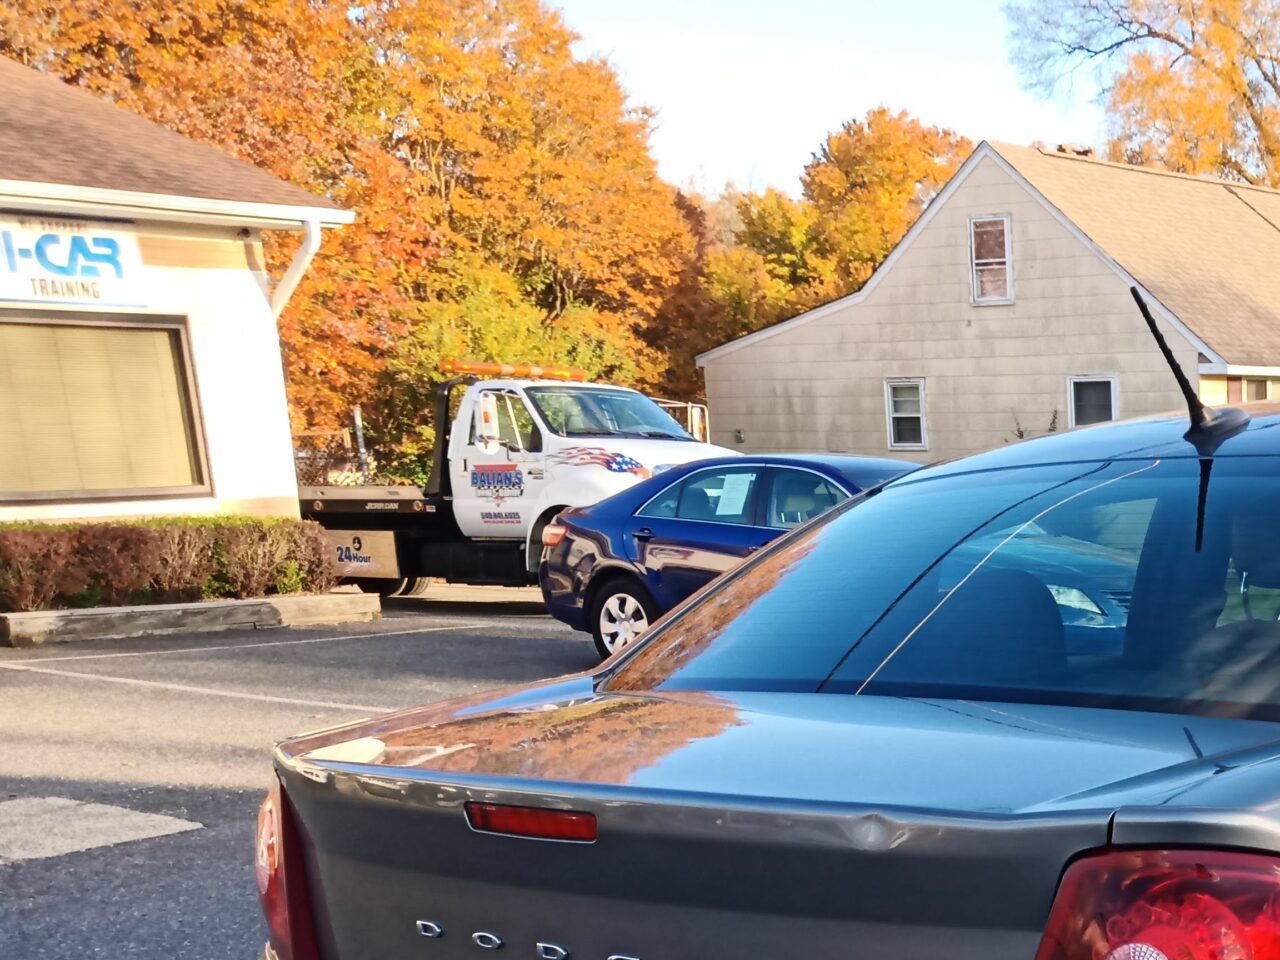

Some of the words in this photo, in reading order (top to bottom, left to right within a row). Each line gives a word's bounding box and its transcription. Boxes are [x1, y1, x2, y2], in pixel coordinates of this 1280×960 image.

[1, 230, 124, 278] I-CAR
[30, 278, 100, 299] TRAINING
[336, 546, 353, 563] 24
